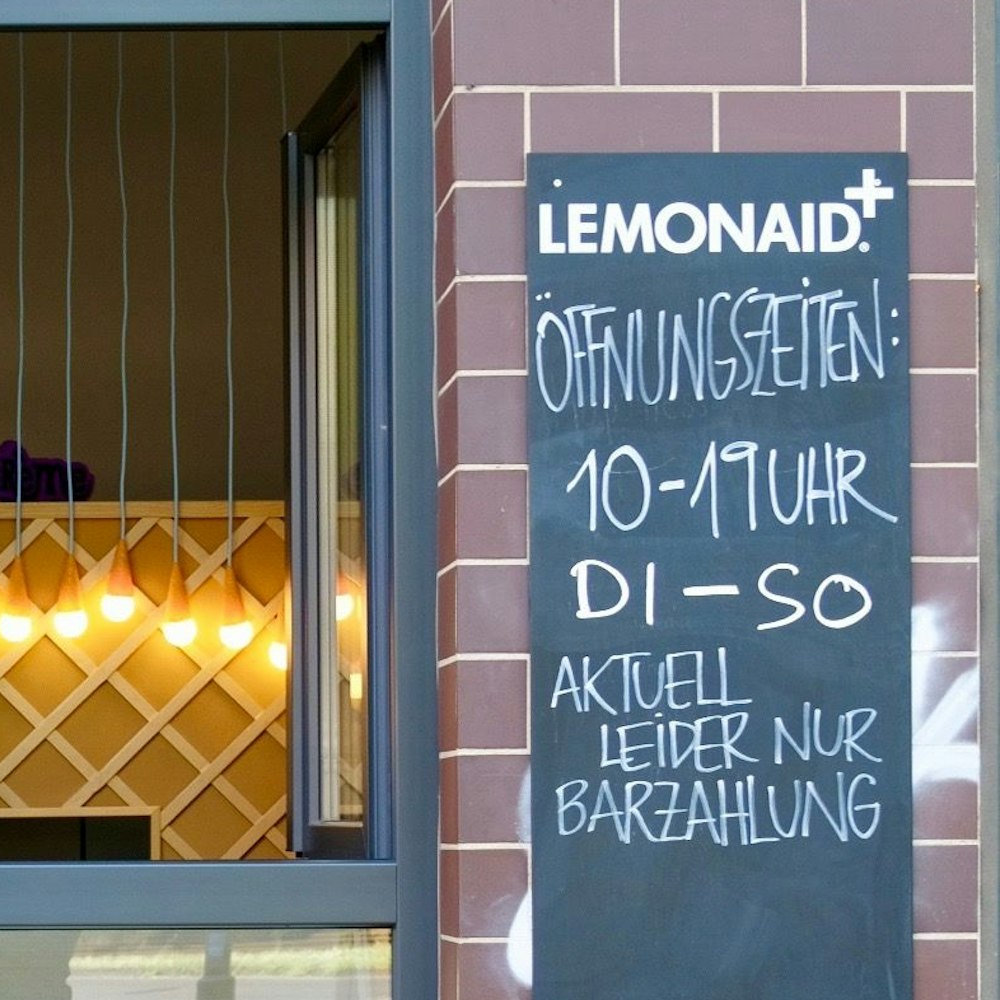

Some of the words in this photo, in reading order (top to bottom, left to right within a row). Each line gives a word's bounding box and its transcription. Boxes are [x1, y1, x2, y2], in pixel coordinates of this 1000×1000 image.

[767, 442, 898, 524] UHR
[570, 559, 655, 626] DI
[756, 563, 873, 630] SO
[550, 646, 753, 716] AKTUELL
[600, 712, 760, 773] LEIDER
[774, 701, 883, 765] NUR
[555, 771, 881, 846] BARZAHLUNG
